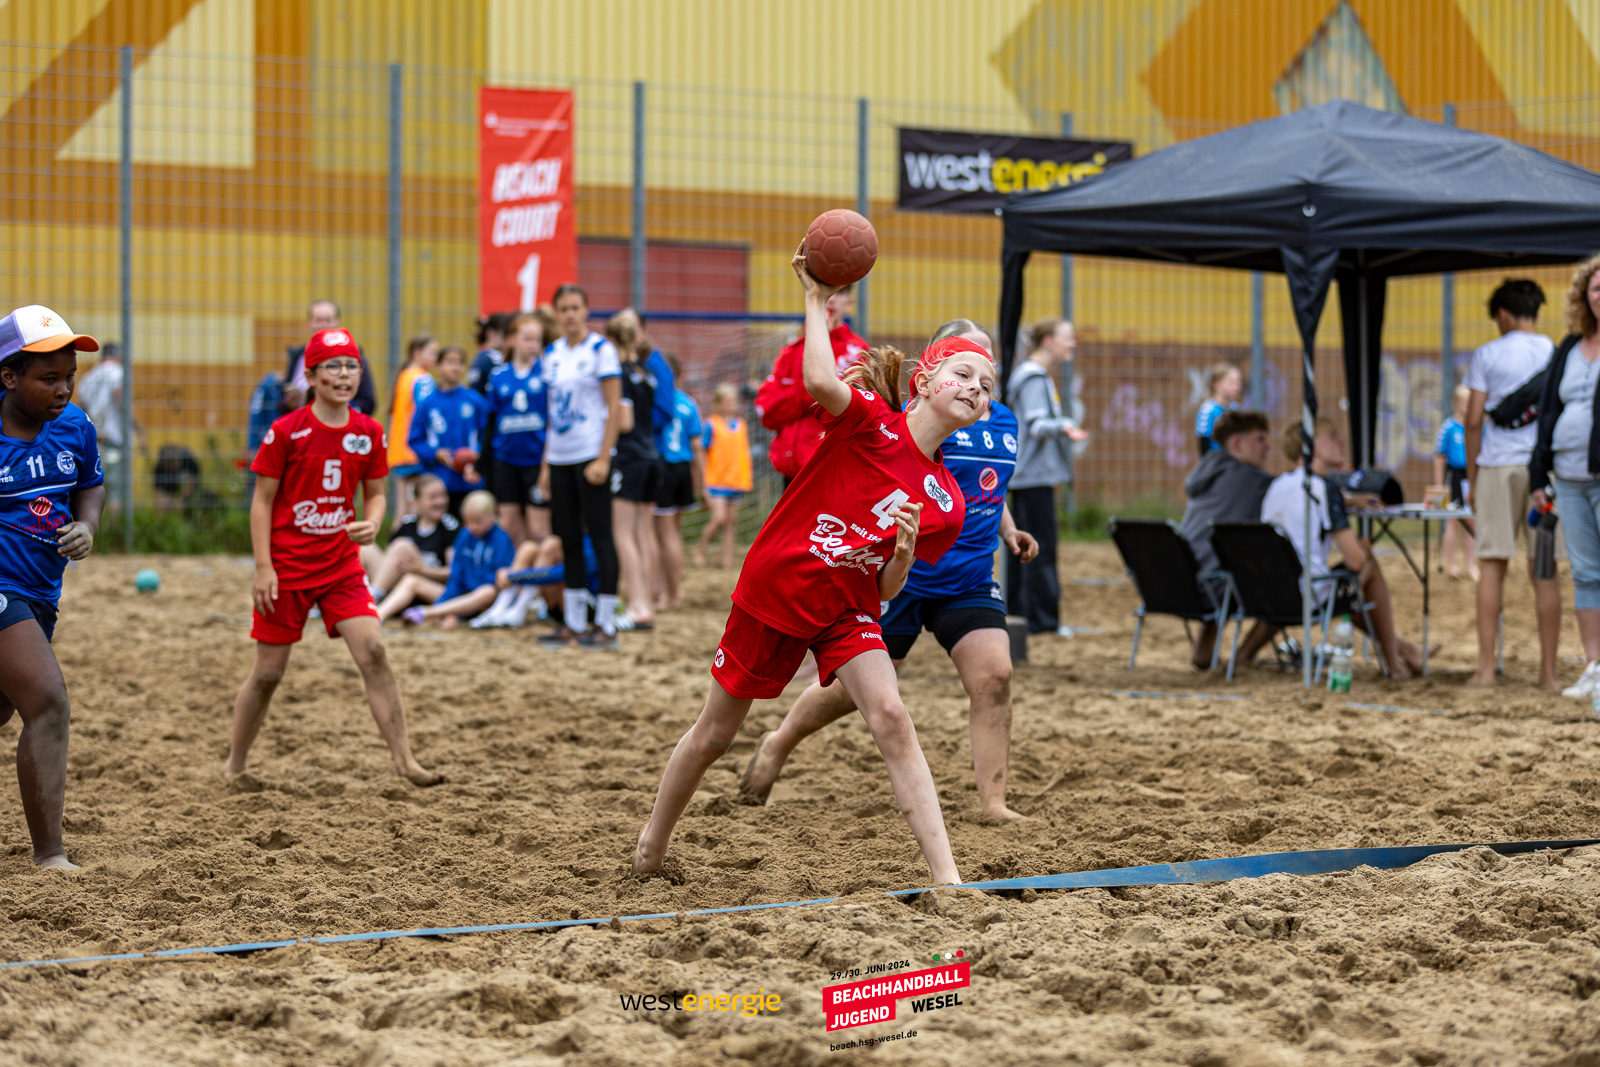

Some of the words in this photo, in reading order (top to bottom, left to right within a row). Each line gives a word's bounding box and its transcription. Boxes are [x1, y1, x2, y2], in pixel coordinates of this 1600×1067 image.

[491, 157, 562, 203] BEACH
[904, 149, 1108, 193] westener
[492, 202, 563, 247] COURT
[516, 253, 541, 312] 1
[934, 380, 964, 395] WESEL
[982, 430, 994, 450] 8
[26, 455, 46, 478] 11
[322, 458, 342, 491] 5
[870, 488, 911, 531] 4
[849, 522, 868, 539] seit
